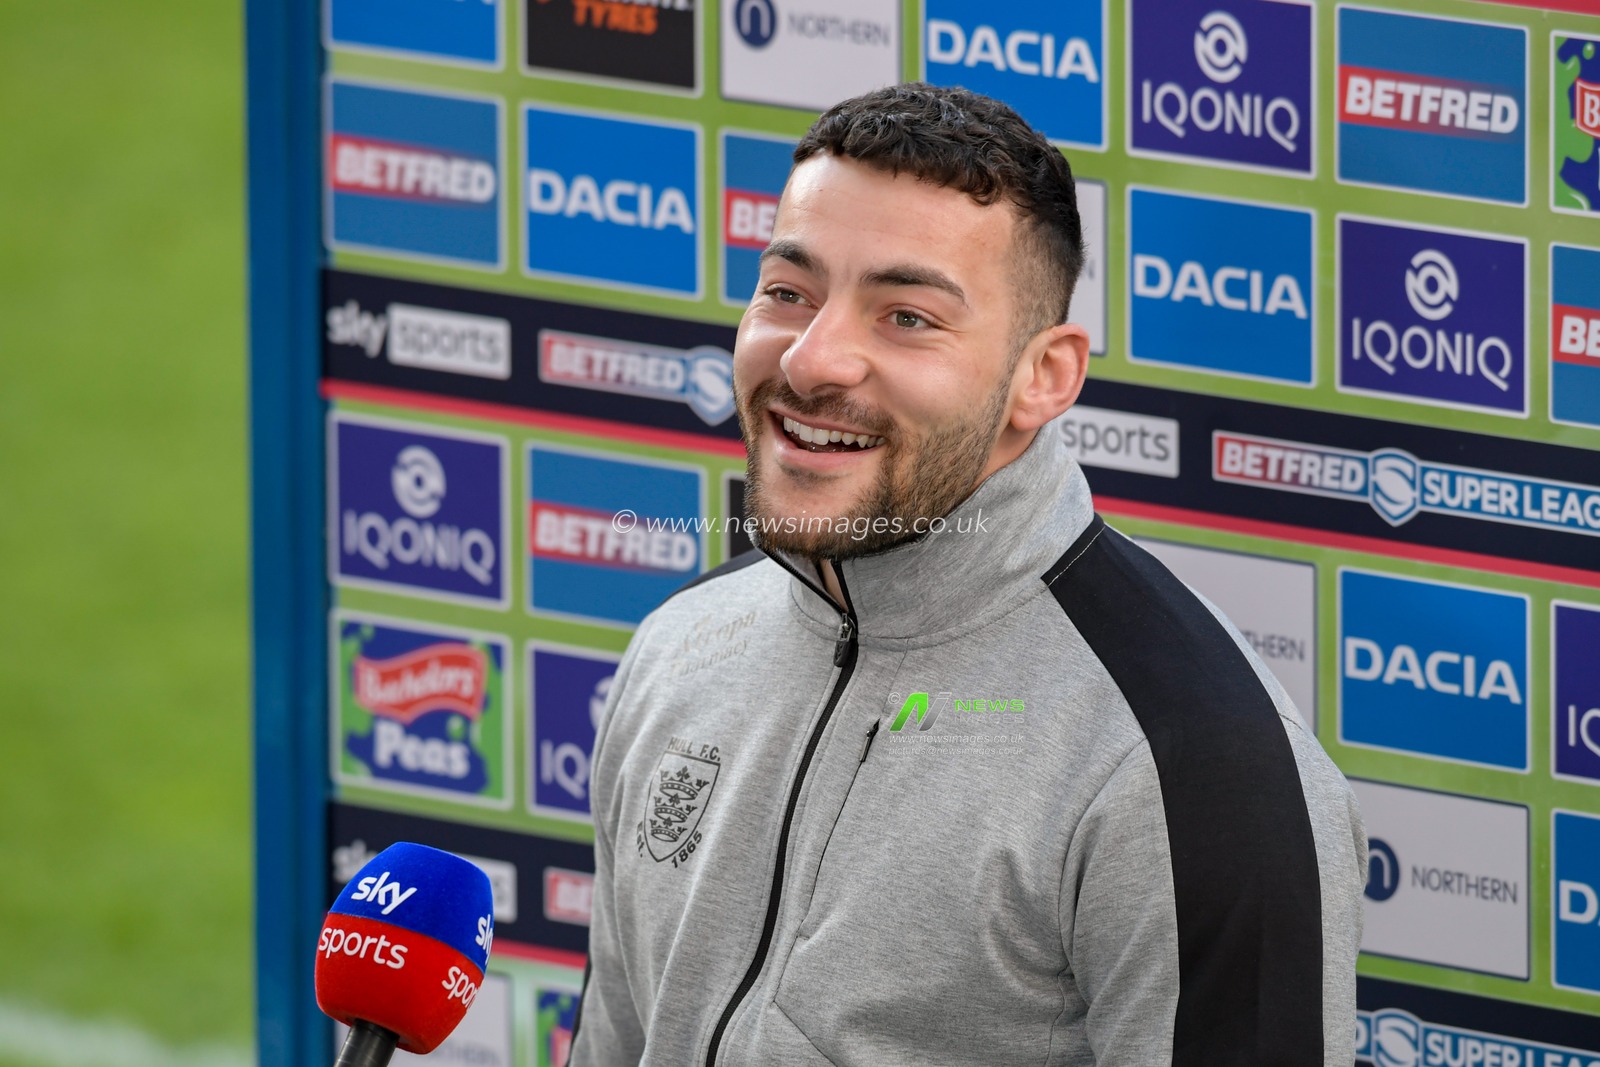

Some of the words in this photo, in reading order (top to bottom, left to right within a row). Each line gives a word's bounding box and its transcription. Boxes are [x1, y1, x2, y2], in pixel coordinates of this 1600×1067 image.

[788, 14, 891, 46] NORTHERN
[927, 19, 1099, 83] DACIA
[1142, 79, 1300, 152] IQONIQ
[1345, 76, 1519, 134] BETFRED
[335, 142, 497, 203] BETFRED
[529, 168, 694, 234] DACIA
[1133, 254, 1308, 319] DACIA
[326, 299, 387, 358] sky
[398, 318, 502, 366] sports
[1351, 317, 1513, 391] IQONIQ
[549, 344, 684, 393] BETFRED
[1061, 419, 1170, 463] sports
[1220, 440, 1366, 493] BETFRED
[1423, 470, 1519, 517] SUPER
[343, 509, 495, 586] IQONIQ
[534, 509, 698, 573] BETFRED
[1345, 637, 1522, 705] DACIA
[374, 719, 471, 779] Peas
[540, 739, 592, 800] IQ
[667, 737, 693, 754] HULL
[699, 744, 721, 761] F.C.
[671, 830, 703, 868] 1865
[350, 871, 418, 916] sky
[1411, 865, 1518, 904] NORTHERN
[318, 927, 408, 970] sports
